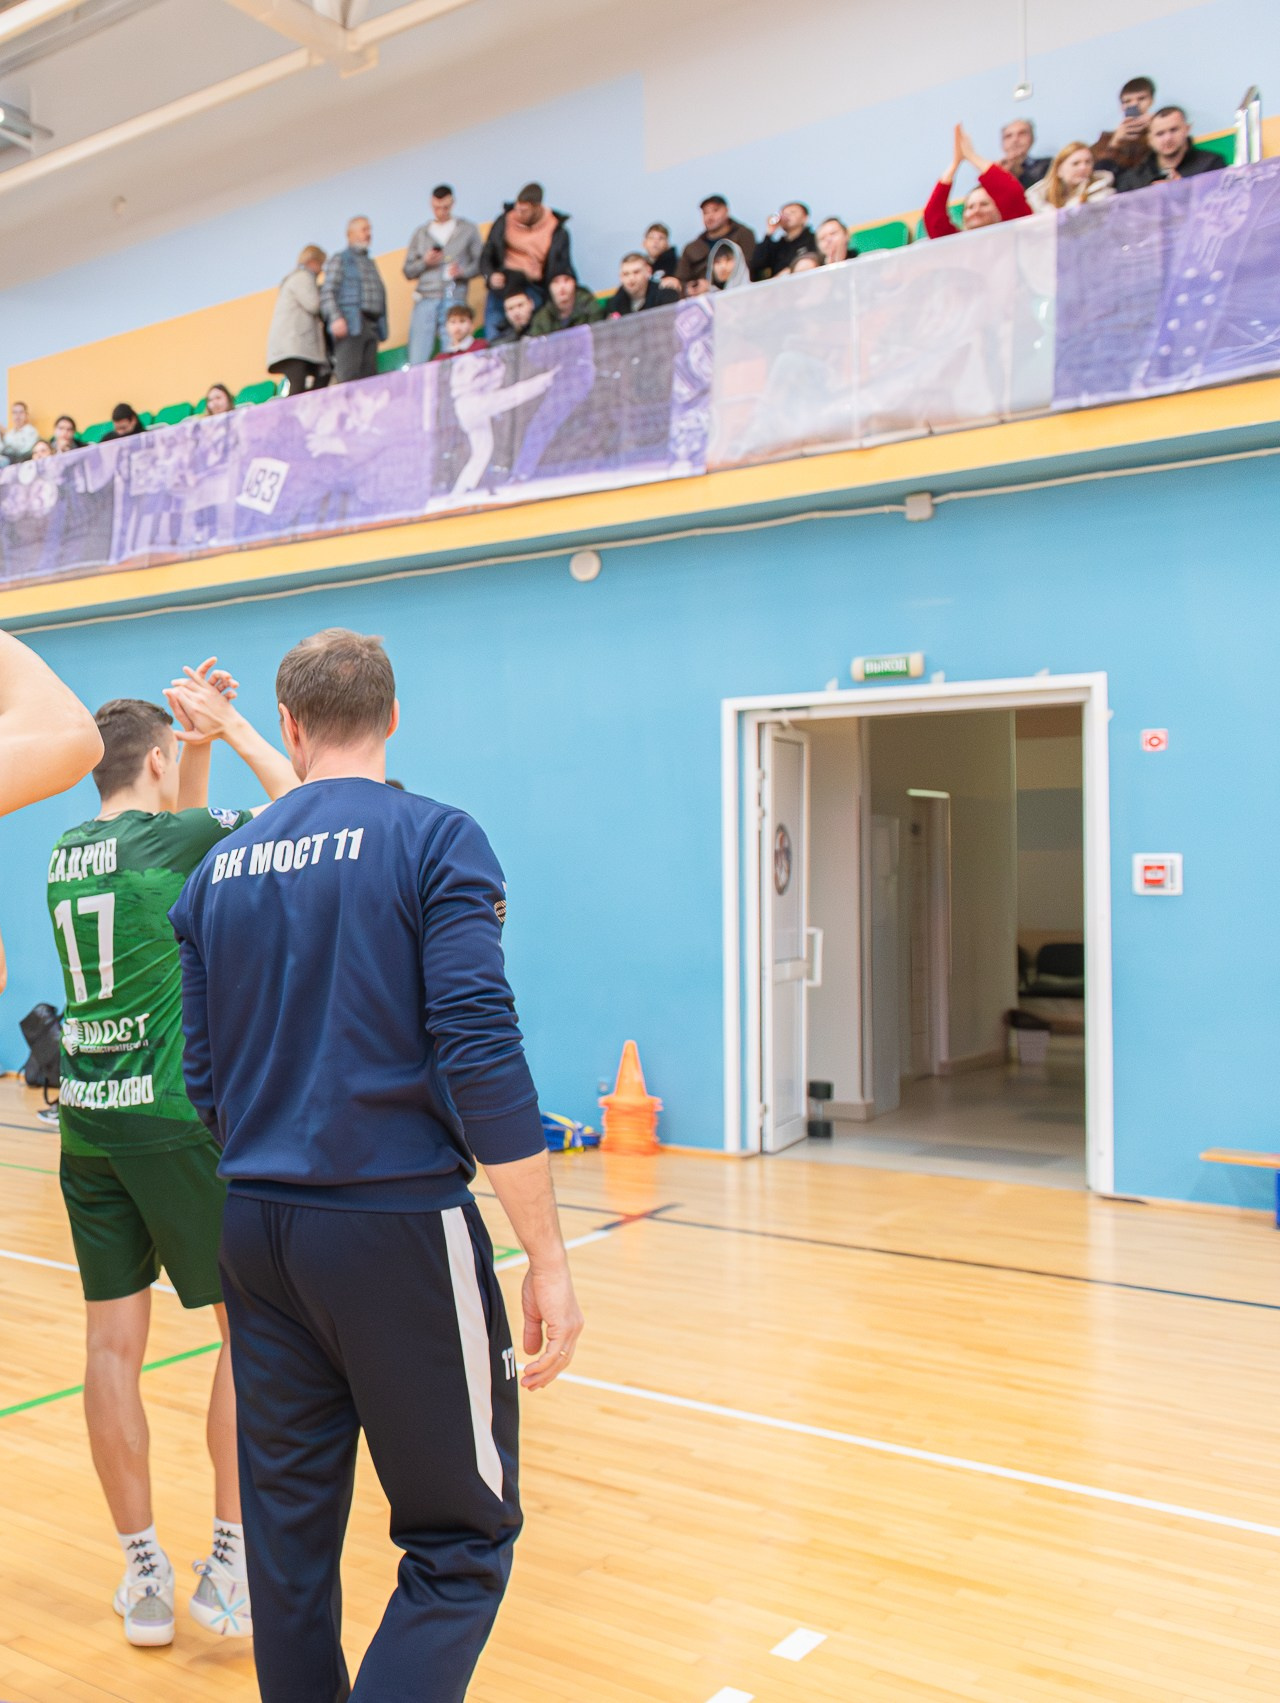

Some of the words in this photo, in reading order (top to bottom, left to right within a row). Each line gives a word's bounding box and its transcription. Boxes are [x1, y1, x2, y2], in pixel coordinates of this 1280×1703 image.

[211, 846, 247, 885] ВК
[248, 832, 330, 875] МОСТ
[333, 827, 364, 861] 11
[54, 892, 116, 1004] 17
[81, 1013, 150, 1045] МОСТ
